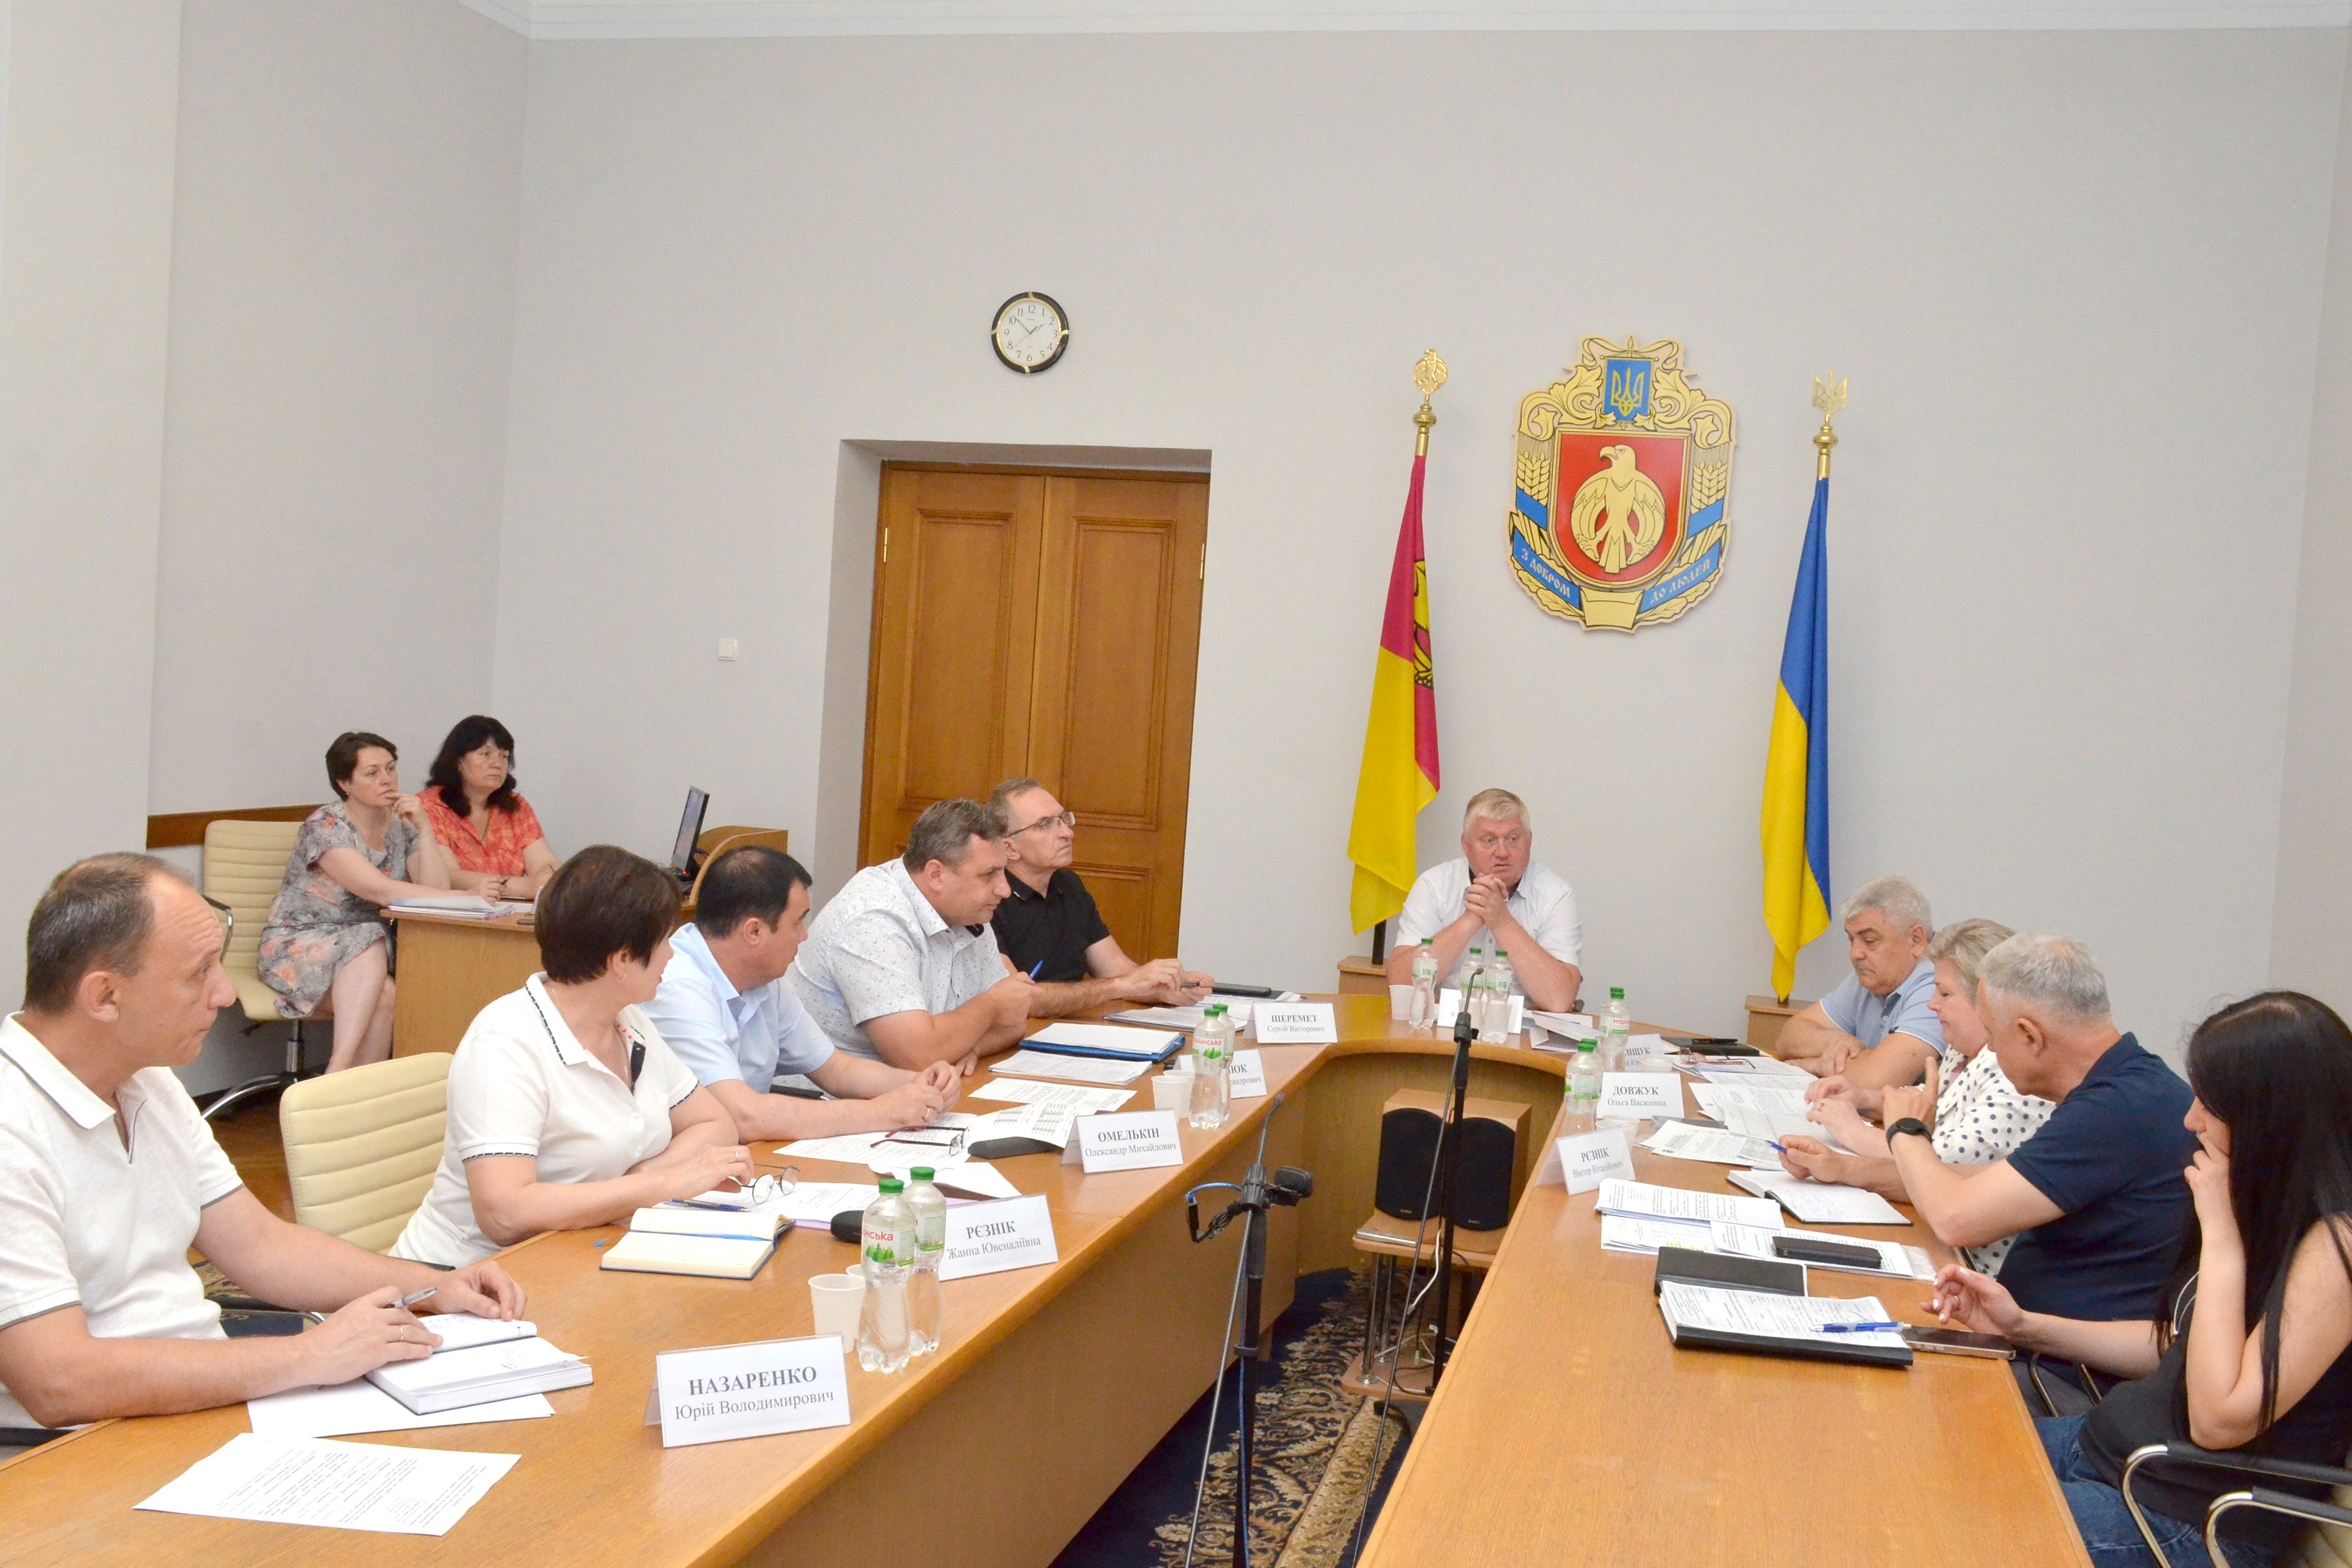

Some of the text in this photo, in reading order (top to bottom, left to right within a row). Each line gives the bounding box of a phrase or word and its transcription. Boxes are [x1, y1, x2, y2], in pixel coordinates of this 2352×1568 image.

[1018, 308, 1023, 316] 11
[1028, 305, 1036, 313] 12
[1009, 316, 1016, 324] 10
[1049, 317, 1054, 325] 2
[1004, 328, 1010, 337] 9
[1053, 330, 1058, 338] 3
[1007, 341, 1013, 349] 8
[1017, 350, 1021, 358] 7
[1027, 353, 1032, 361] 6
[1040, 350, 1045, 359] 5
[1521, 549, 1711, 604] З ДОБРОМ ДО ЛЮДЕЙ
[1613, 1086, 1659, 1096] ДОВЖУК
[1607, 1099, 1666, 1107] Ольга Василівна
[1098, 1128, 1159, 1142] ОМЕЛЬКІН
[1085, 1143, 1176, 1157] Олександр Михайлович
[1581, 1148, 1609, 1163] РЄЗНІК
[1573, 1167, 1592, 1178] Віктор
[967, 1221, 1017, 1239] РЄЗНІК
[947, 1237, 1041, 1259] Жанна Ювеналіївна
[689, 1366, 817, 1395] НАЗАРЕНКО
[675, 1391, 834, 1421] Юрій Володимирович
